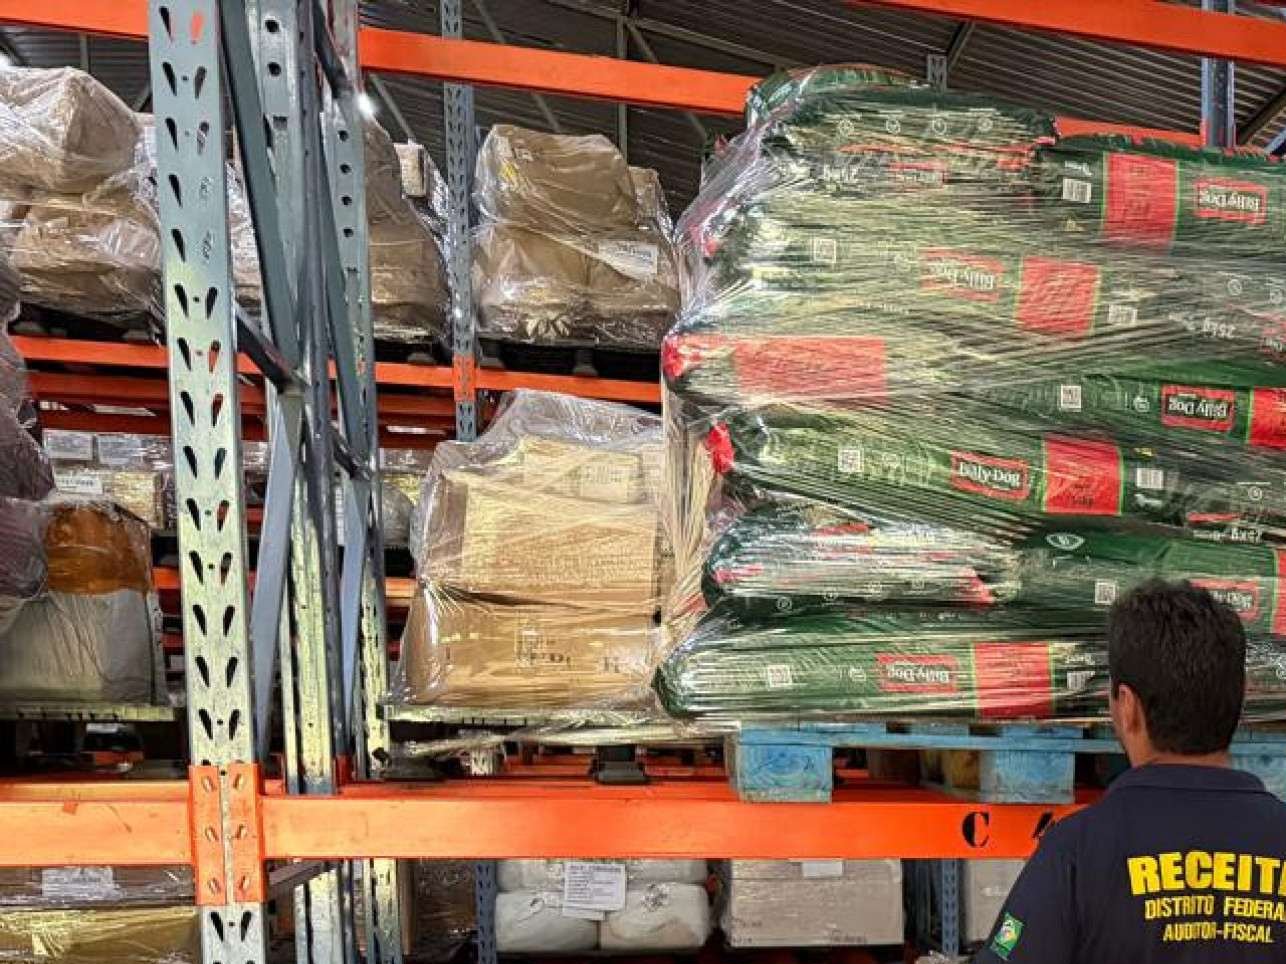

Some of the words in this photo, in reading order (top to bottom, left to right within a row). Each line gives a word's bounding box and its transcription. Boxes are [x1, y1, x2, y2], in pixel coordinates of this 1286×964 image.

[1168, 396, 1196, 415] Dog
[1196, 398, 1229, 418] Billy
[962, 811, 990, 848] C
[1144, 895, 1214, 920] DISTRITO
